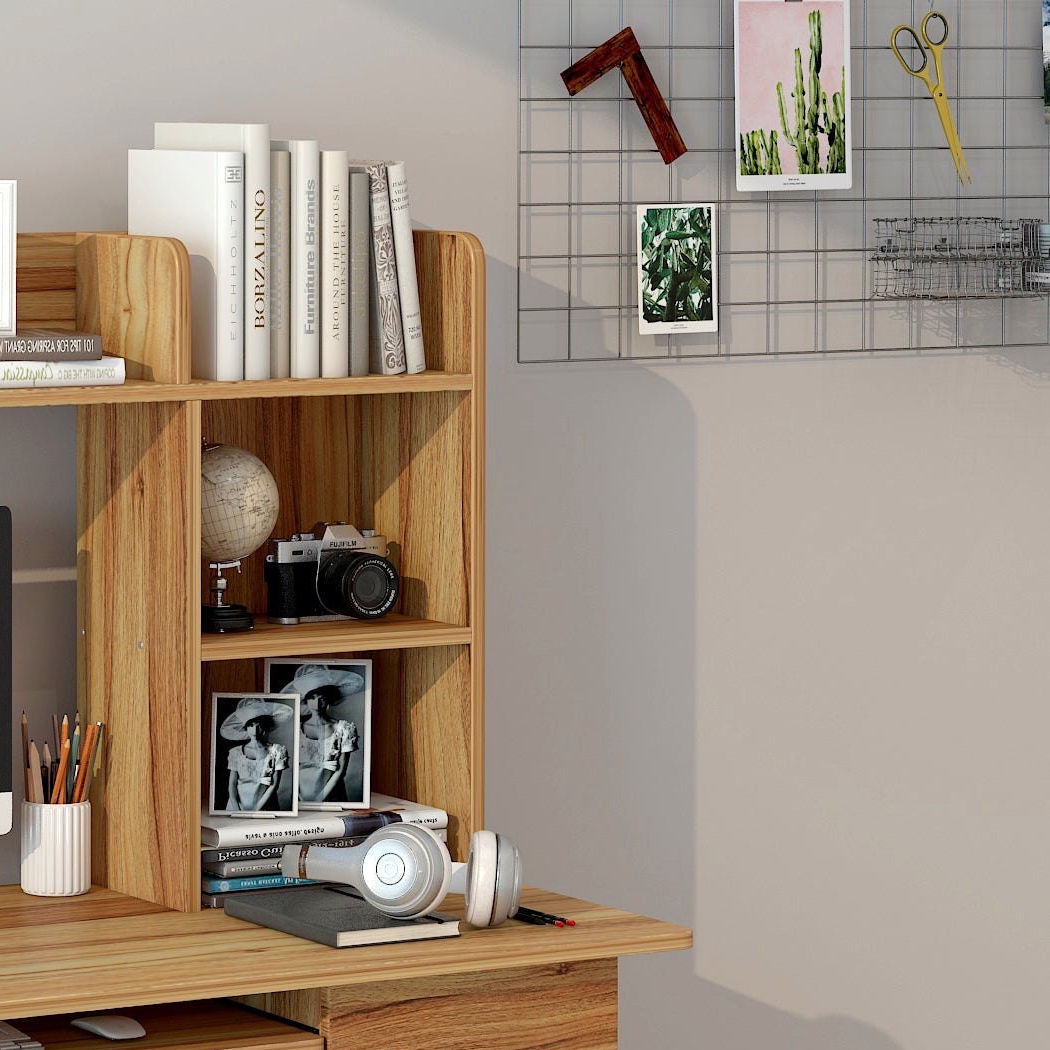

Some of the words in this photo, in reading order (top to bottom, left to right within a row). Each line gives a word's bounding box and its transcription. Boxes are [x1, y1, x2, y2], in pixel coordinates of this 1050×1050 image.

[304, 179, 316, 245] Brands
[332, 184, 340, 234] HOUSE
[230, 199, 238, 342] EICHHOLTZ
[254, 189, 267, 330] BORZALINO
[332, 241, 340, 272] THE
[351, 230, 367, 318] arketipo
[304, 251, 316, 335] Furniture
[332, 277, 340, 341] AROUND
[329, 540, 357, 548] FUJIFILM
